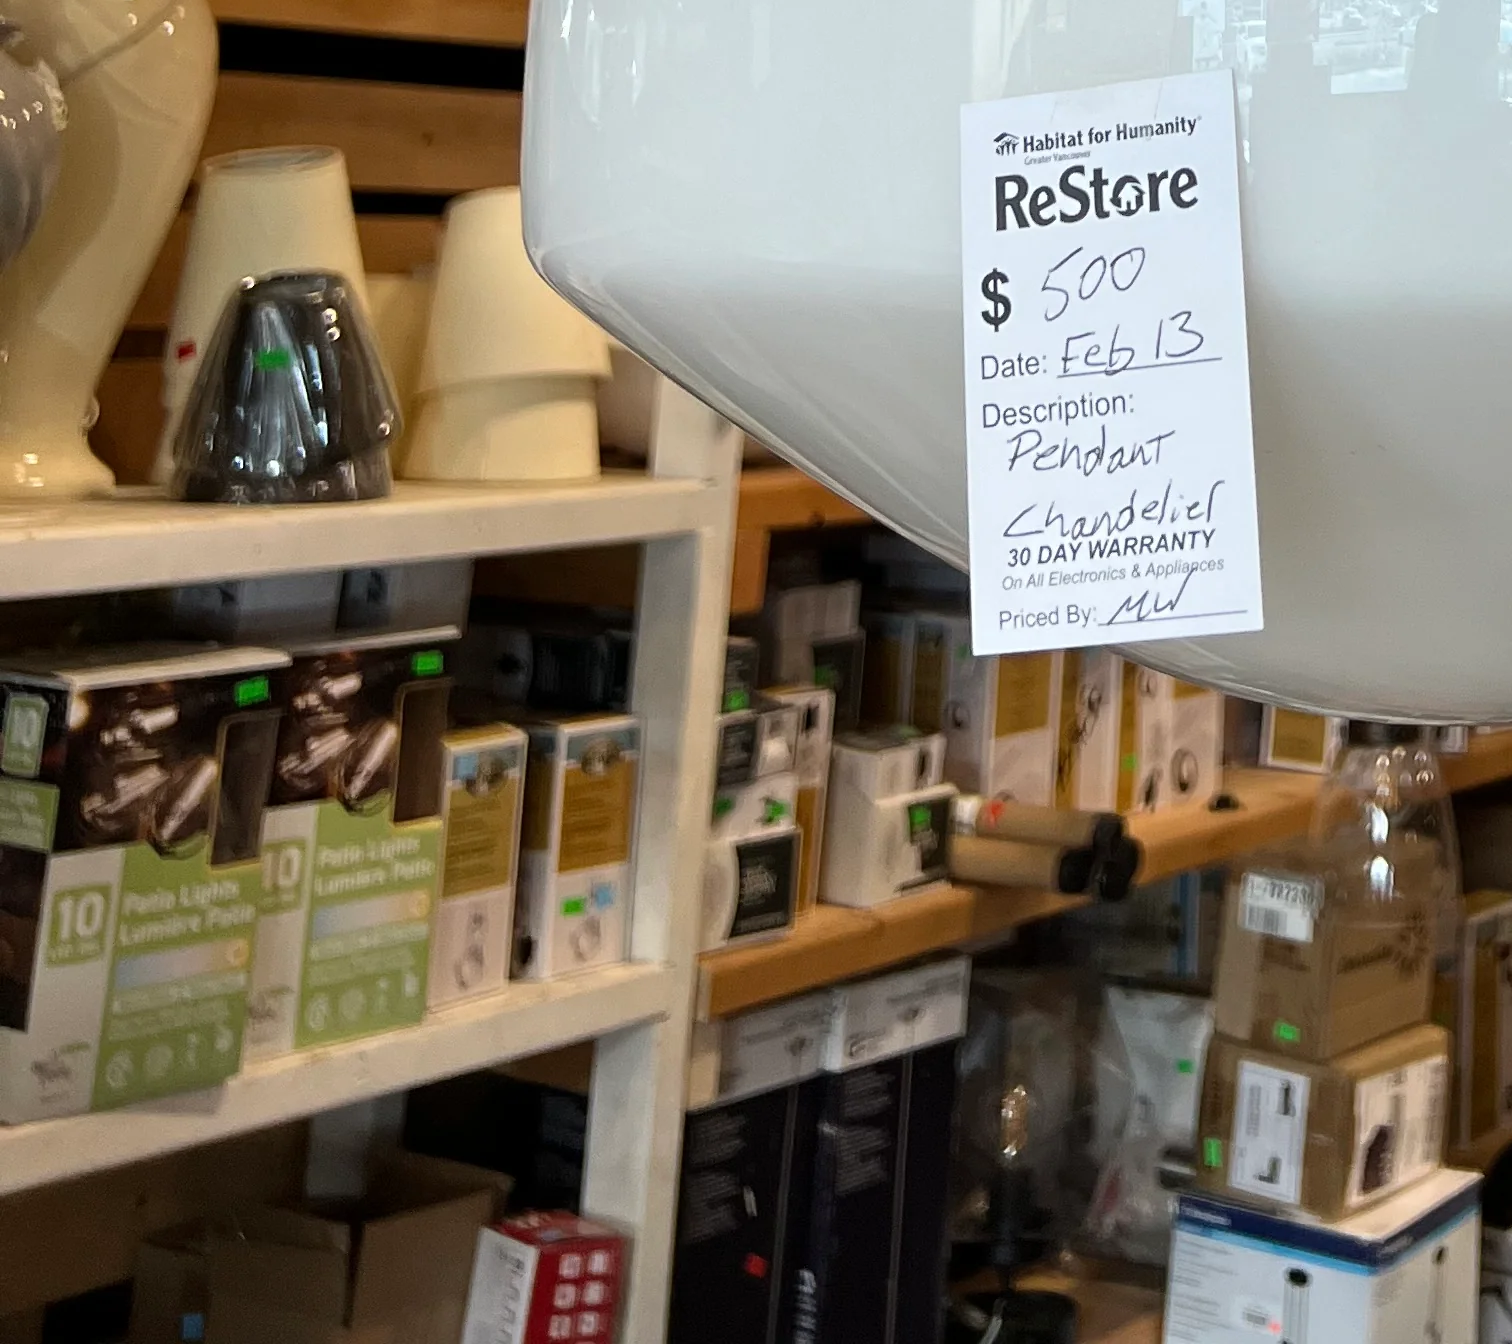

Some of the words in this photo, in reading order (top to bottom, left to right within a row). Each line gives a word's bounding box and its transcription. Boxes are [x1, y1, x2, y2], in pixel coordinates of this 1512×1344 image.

[1023, 129, 1083, 153] Habitat
[1088, 127, 1111, 145] for
[1116, 115, 1198, 141] Humanity
[995, 165, 1200, 232] ReStore
[981, 266, 1012, 333] $
[1041, 246, 1146, 322] 500
[981, 353, 1047, 380] Date:
[1062, 324, 1135, 376] Feb
[1155, 310, 1204, 360] 13
[982, 391, 1134, 428] Description:
[1007, 547, 1031, 568] 30
[1038, 541, 1083, 565] DAY
[1088, 528, 1216, 560] WARRANTY
[1002, 575, 1023, 591] On
[1026, 571, 1044, 588] All
[1049, 566, 1126, 587] Electronics
[1131, 563, 1142, 578] &
[1145, 557, 1225, 580] Appliances
[999, 605, 1060, 630] Priced
[1067, 604, 1097, 628] By:
[262, 846, 301, 892] 10
[57, 891, 104, 942] 10
